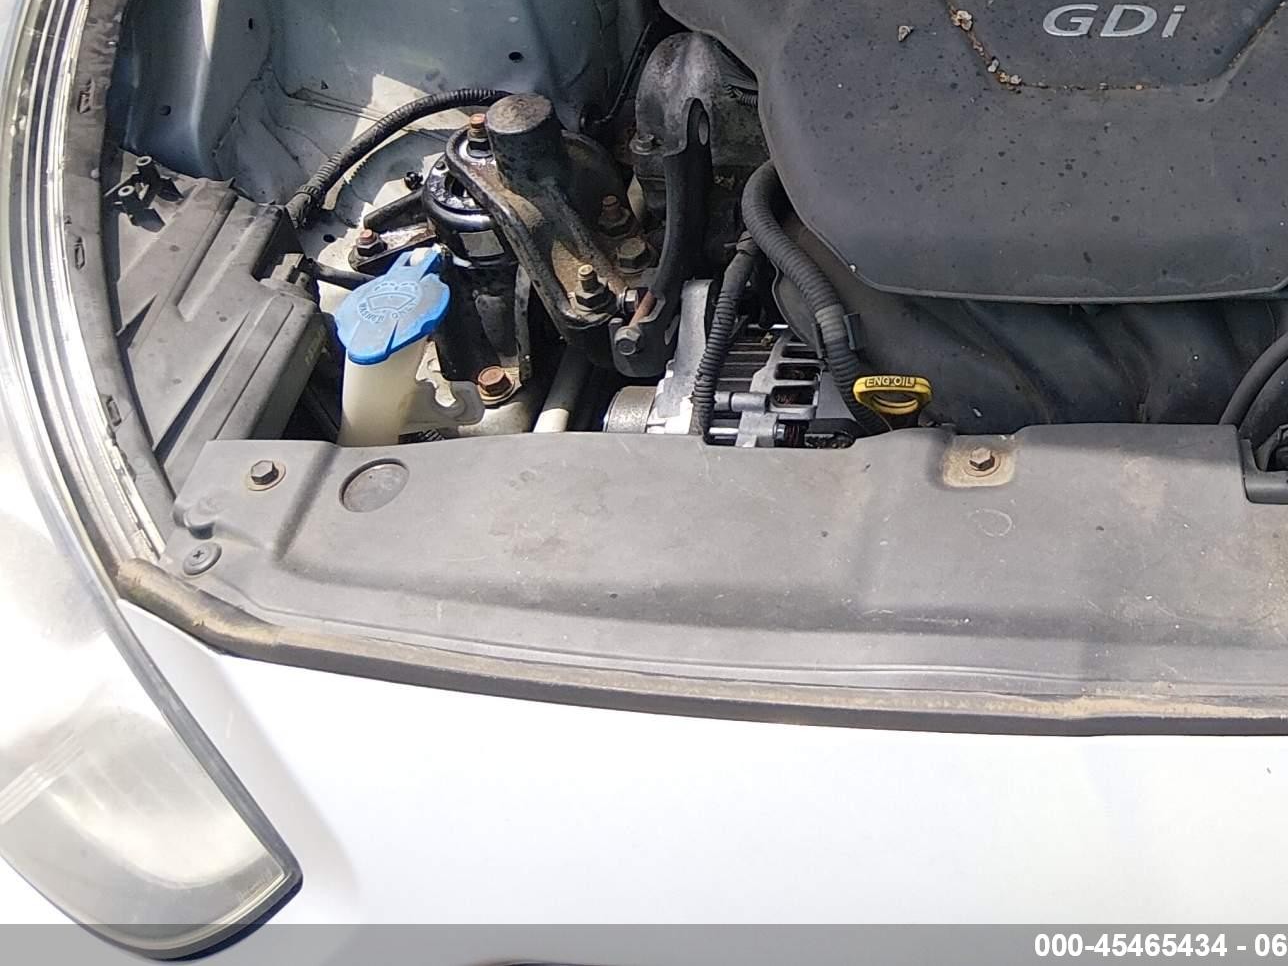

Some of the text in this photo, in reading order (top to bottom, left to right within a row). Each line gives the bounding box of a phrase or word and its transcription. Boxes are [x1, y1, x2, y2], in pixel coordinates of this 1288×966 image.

[1042, 3, 1187, 38] GDi
[866, 376, 913, 387] ENG OIL
